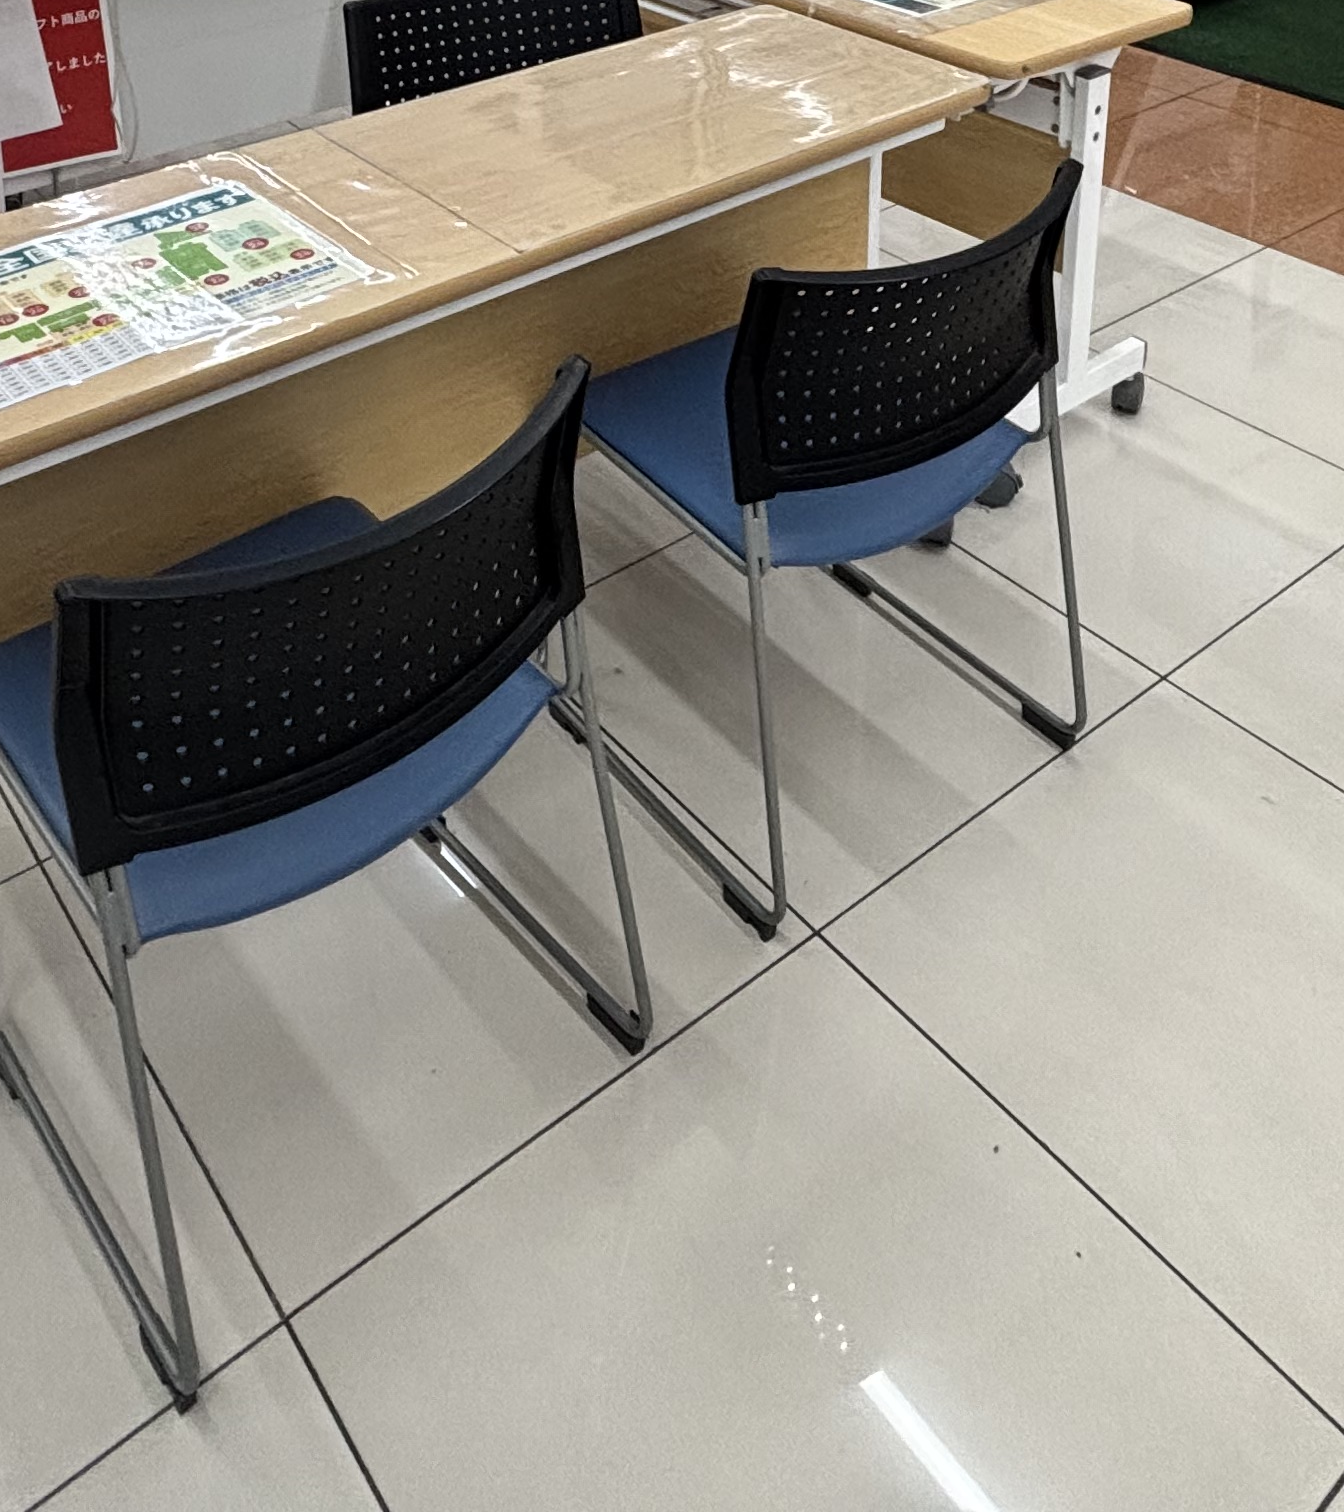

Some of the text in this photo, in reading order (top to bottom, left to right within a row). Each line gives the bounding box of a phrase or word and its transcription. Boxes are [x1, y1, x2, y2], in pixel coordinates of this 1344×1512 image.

[36, 7, 102, 33] フト商品の
[48, 51, 107, 72] しました
